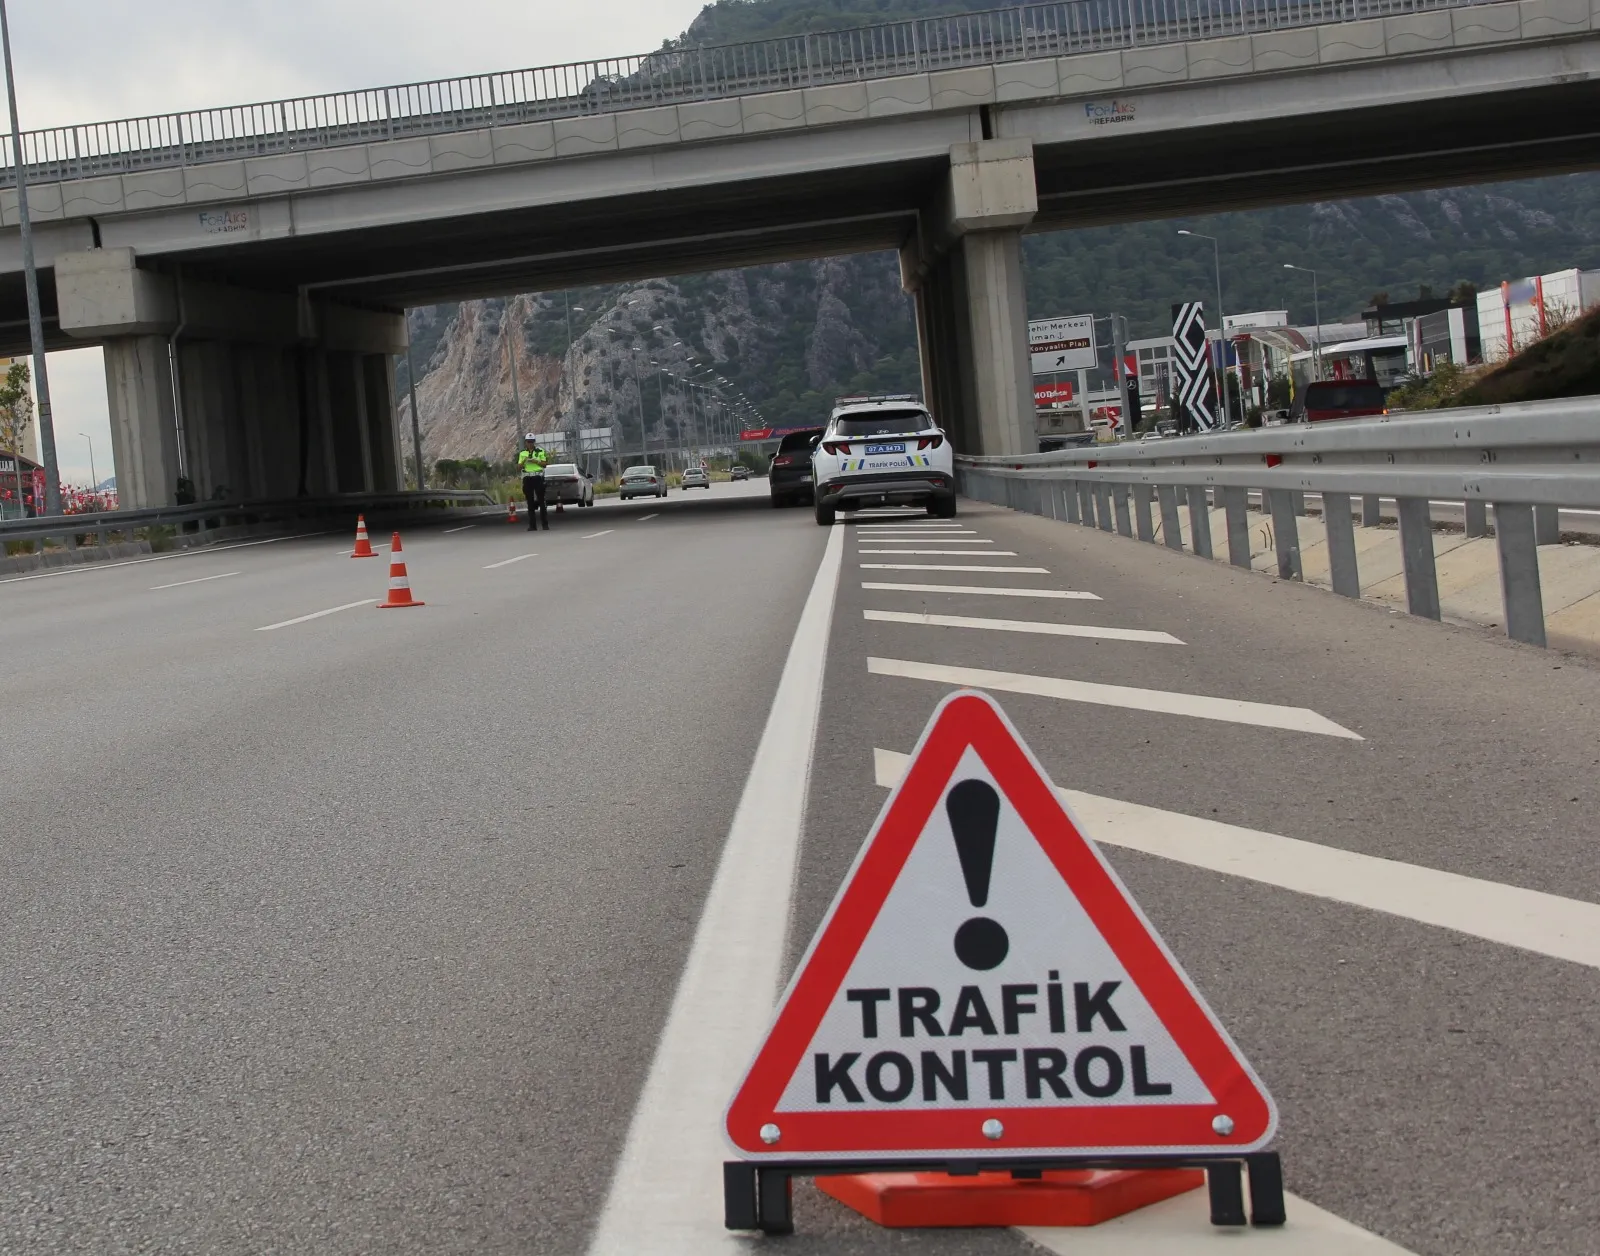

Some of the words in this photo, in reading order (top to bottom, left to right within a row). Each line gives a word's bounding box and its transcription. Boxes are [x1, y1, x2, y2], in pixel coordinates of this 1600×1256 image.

[1029, 334, 1055, 342] iman
[1050, 321, 1087, 330] Merkezi
[847, 970, 1127, 1039] TRAFİK
[814, 1045, 1172, 1103] KONTROL
